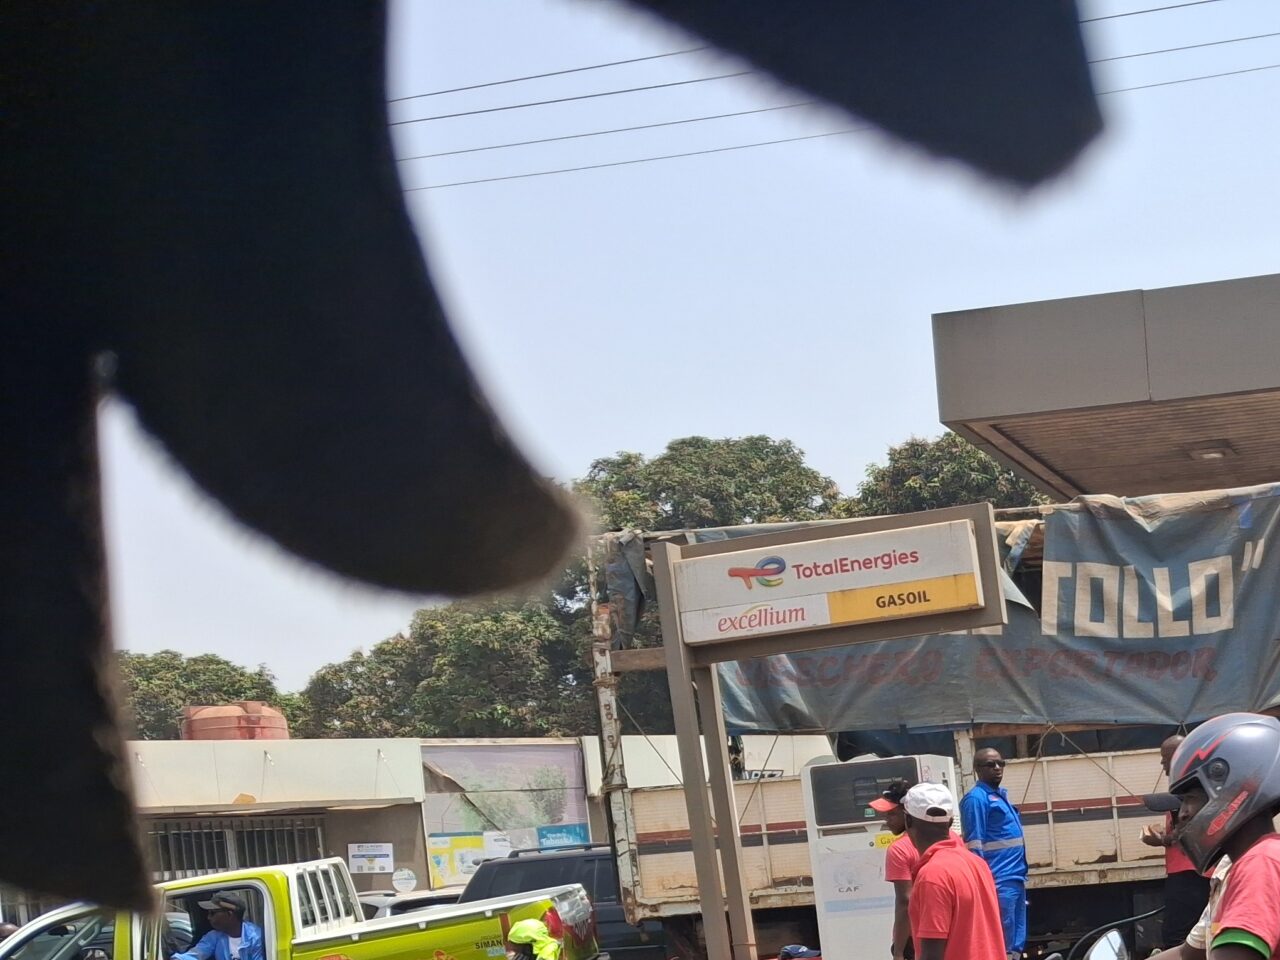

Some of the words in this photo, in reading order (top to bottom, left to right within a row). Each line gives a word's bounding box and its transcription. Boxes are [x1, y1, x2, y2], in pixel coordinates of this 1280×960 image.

[792, 550, 920, 580] TotalEnergies
[875, 590, 931, 609] GASOIL
[717, 605, 806, 633] excellium
